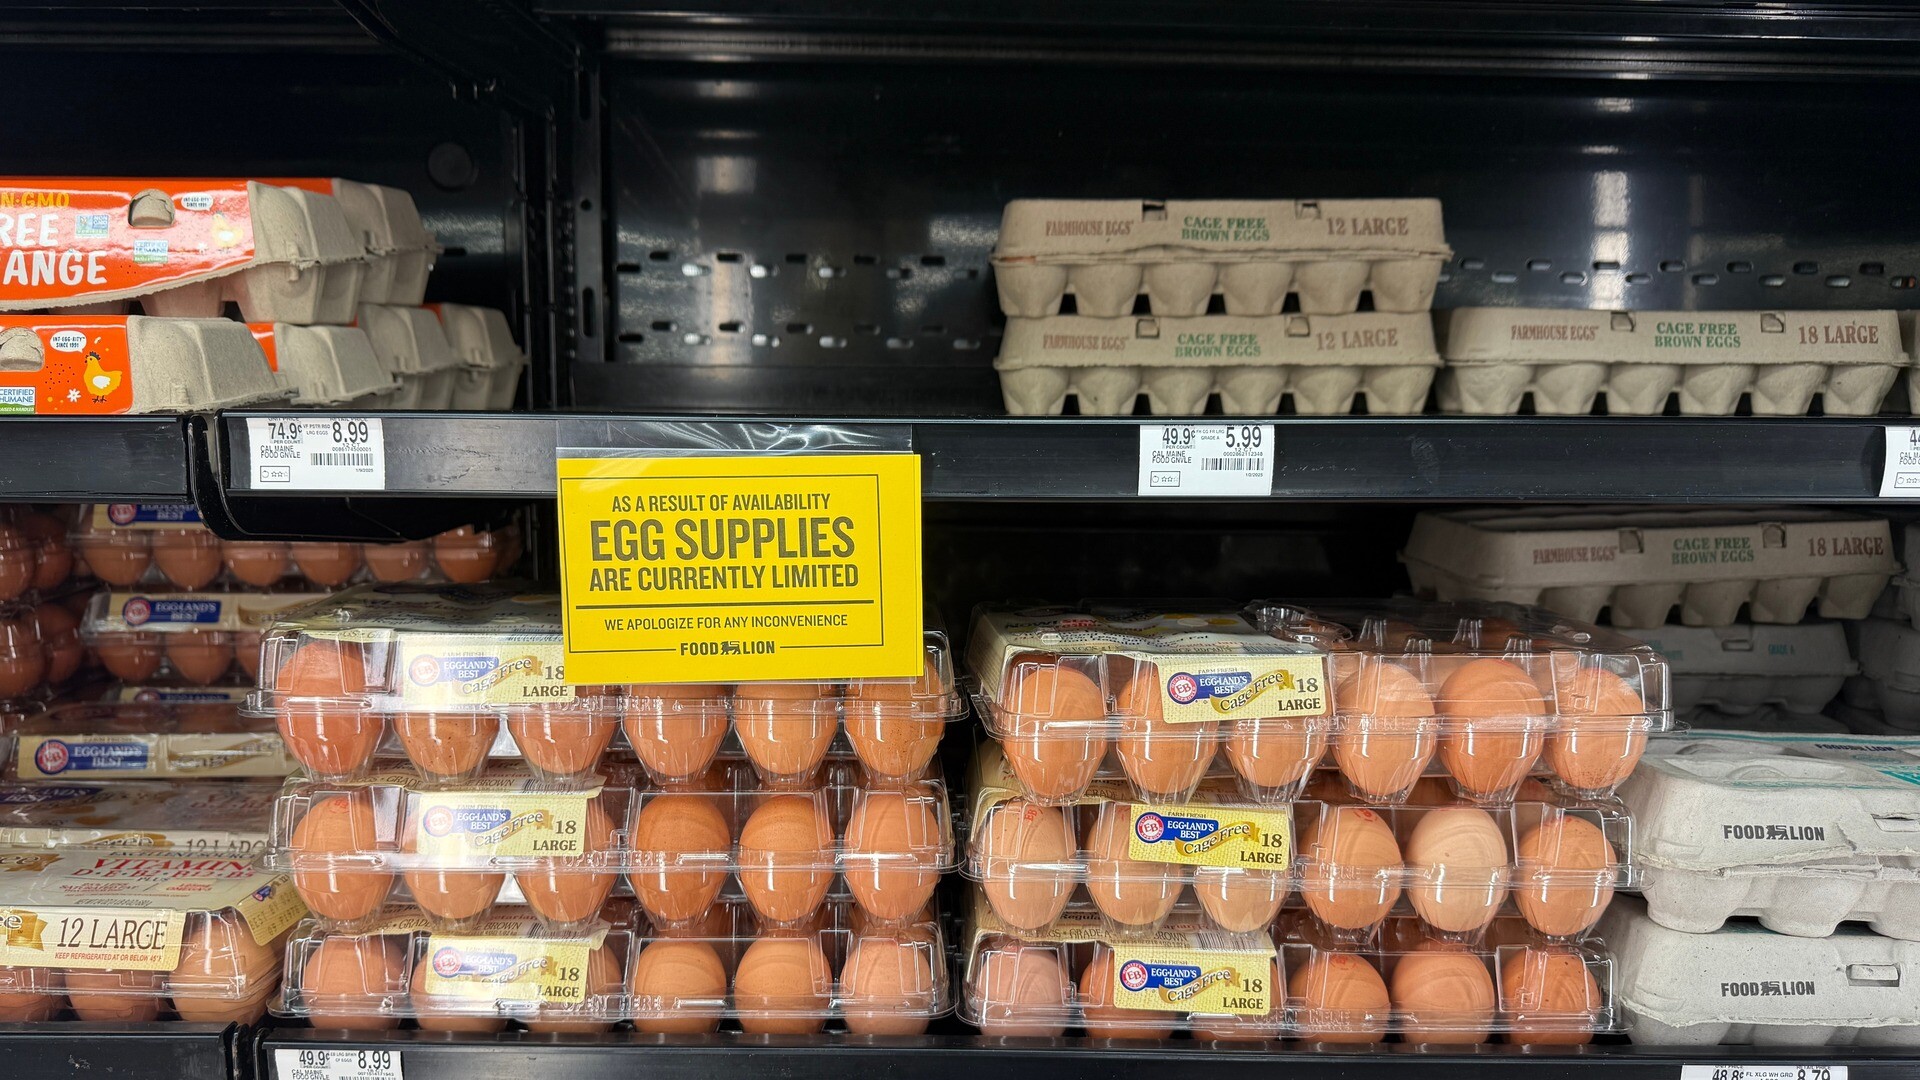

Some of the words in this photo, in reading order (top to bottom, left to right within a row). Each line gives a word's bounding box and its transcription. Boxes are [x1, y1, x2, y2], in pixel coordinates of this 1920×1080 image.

[1045, 221, 1103, 237] FARMHOUSE
[1184, 216, 1222, 228] CAGE
[1227, 217, 1266, 229] FREE
[1327, 217, 1345, 235] 12
[1352, 217, 1409, 236] LARGE
[1182, 229, 1229, 240] BROWN
[1234, 230, 1270, 241] EGGS
[3, 250, 107, 287] ANGE
[1511, 325, 1568, 341] FARMHOUSE
[1656, 322, 1694, 335] CAGE
[1699, 323, 1737, 335] FREE
[1799, 326, 1819, 344] 18
[1824, 325, 1878, 344] LARGE
[1177, 333, 1215, 345] CAGE
[1220, 333, 1257, 345] FREE
[1316, 332, 1335, 350] 12
[1341, 329, 1398, 348] LARGE
[1655, 335, 1701, 348] BROWN
[1706, 336, 1741, 348] EGGS
[1175, 346, 1222, 357] BROWN
[1226, 345, 1261, 357] EGGS
[268, 422, 302, 440] 74.9¢
[333, 421, 369, 443] 8.99
[1162, 428, 1196, 445] 49.9¢
[1225, 427, 1262, 448] 5.99
[612, 496, 631, 512] AS
[635, 495, 645, 511] A
[649, 495, 705, 511] RESULT
[709, 495, 728, 511] OF
[732, 493, 831, 510] AVAILABILITY
[590, 518, 666, 562] EGG
[675, 516, 855, 560] SUPPLIES
[1673, 537, 1709, 551] CAGE
[1714, 536, 1751, 550] FREE
[1808, 537, 1826, 557] 18
[1833, 537, 1885, 556] LARGE
[1533, 547, 1588, 564] FARMHOUSE
[1672, 550, 1717, 565] BROWN
[1721, 549, 1755, 563] EGGS
[589, 567, 632, 592] ARE
[638, 565, 766, 591] CURRENTLY
[772, 564, 859, 588] LIMITED
[604, 619, 624, 631] WE
[627, 617, 694, 631] APOLOGIZE
[697, 617, 721, 629] FOR
[724, 616, 748, 628] ANY
[751, 614, 848, 628] INCONVENIENCE
[680, 642, 718, 656] FOOD
[743, 640, 775, 655] LION
[458, 670, 480, 678] BEST
[462, 673, 498, 695] Cage
[500, 658, 532, 679] Free
[545, 666, 564, 680] 18
[523, 685, 568, 697] LARGE
[1176, 682, 1191, 694] EB
[1214, 686, 1235, 694] BEST
[1220, 688, 1252, 711] Cage
[1253, 673, 1284, 695] Free
[1296, 678, 1318, 693] 18
[1278, 698, 1321, 711] LARGE
[92, 757, 123, 767] BEST
[476, 777, 515, 787] BROWN
[471, 821, 492, 830] BEST
[474, 825, 509, 846] Cage
[511, 811, 543, 832] Free
[556, 820, 576, 834] 18
[1144, 822, 1159, 833] EB
[1724, 825, 1764, 840] FOOD
[1787, 825, 1825, 841] LION
[1180, 830, 1201, 839] BEST
[1184, 833, 1217, 854] Cage
[1219, 823, 1250, 842] Free
[1262, 833, 1283, 848] 18
[533, 840, 577, 851] LARGE
[1240, 850, 1283, 864] LARGE
[484, 921, 522, 931] BROWN
[57, 917, 84, 948] 12
[89, 918, 168, 951] LARGE
[1069, 929, 1101, 939] GRADE
[55, 952, 69, 960] KEEP
[70, 953, 111, 961] REFRIGERATED
[120, 953, 129, 961] OR
[478, 964, 498, 973] BEST
[559, 967, 579, 981] 18
[1127, 970, 1142, 980] EB
[1164, 977, 1184, 986] BEST
[1168, 982, 1200, 1002] Cage
[1201, 969, 1231, 989] Free
[1243, 979, 1263, 993] 18
[1721, 982, 1759, 997] FOOD
[1782, 981, 1815, 996] LION
[538, 985, 579, 998] LARGE
[1223, 997, 1263, 1010] LARGE
[299, 1050, 330, 1066] 49.9¢
[358, 1050, 391, 1069] 8.99
